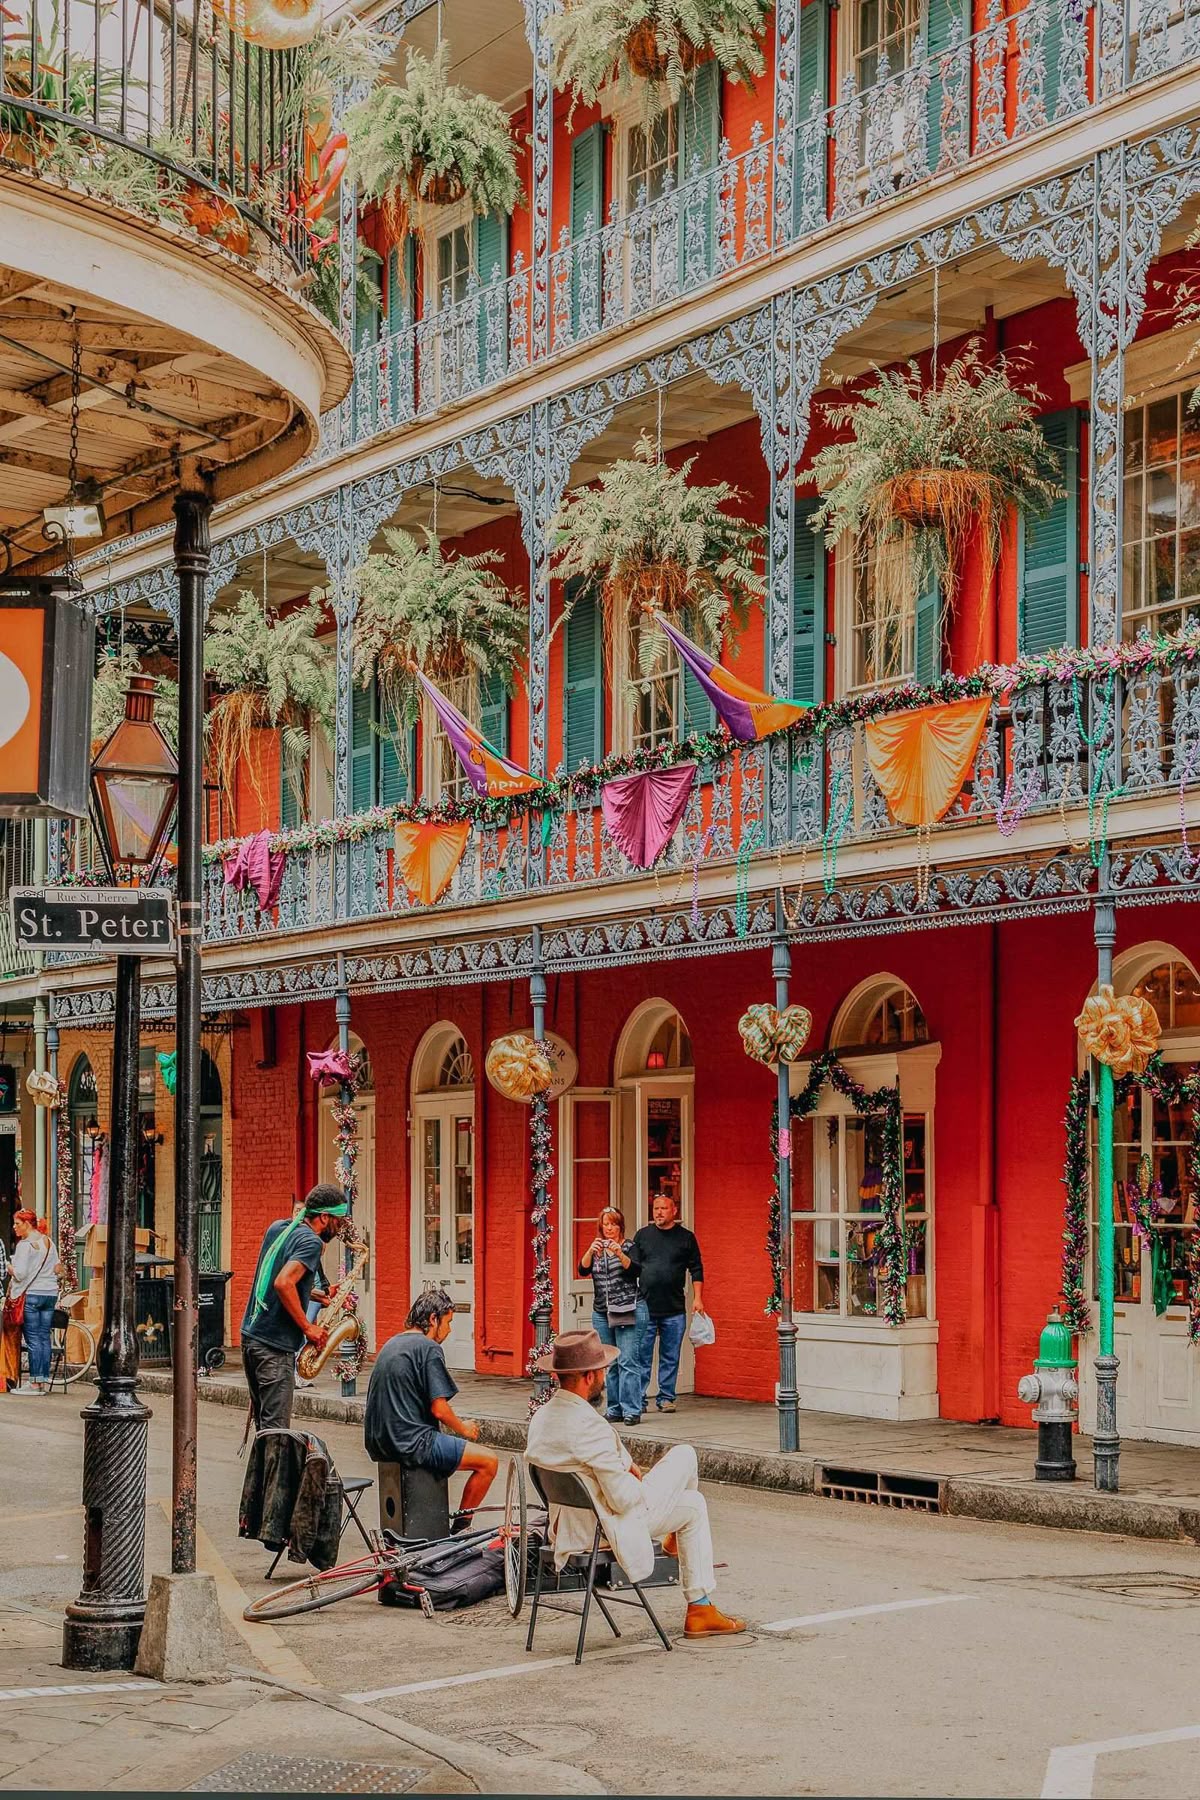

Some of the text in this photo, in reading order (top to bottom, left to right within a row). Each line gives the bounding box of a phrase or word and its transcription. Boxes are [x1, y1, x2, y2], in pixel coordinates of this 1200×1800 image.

[57, 892, 128, 903] Rue St. Pierre
[20, 908, 164, 938] St. Peter
[422, 1279, 437, 1292] 706
